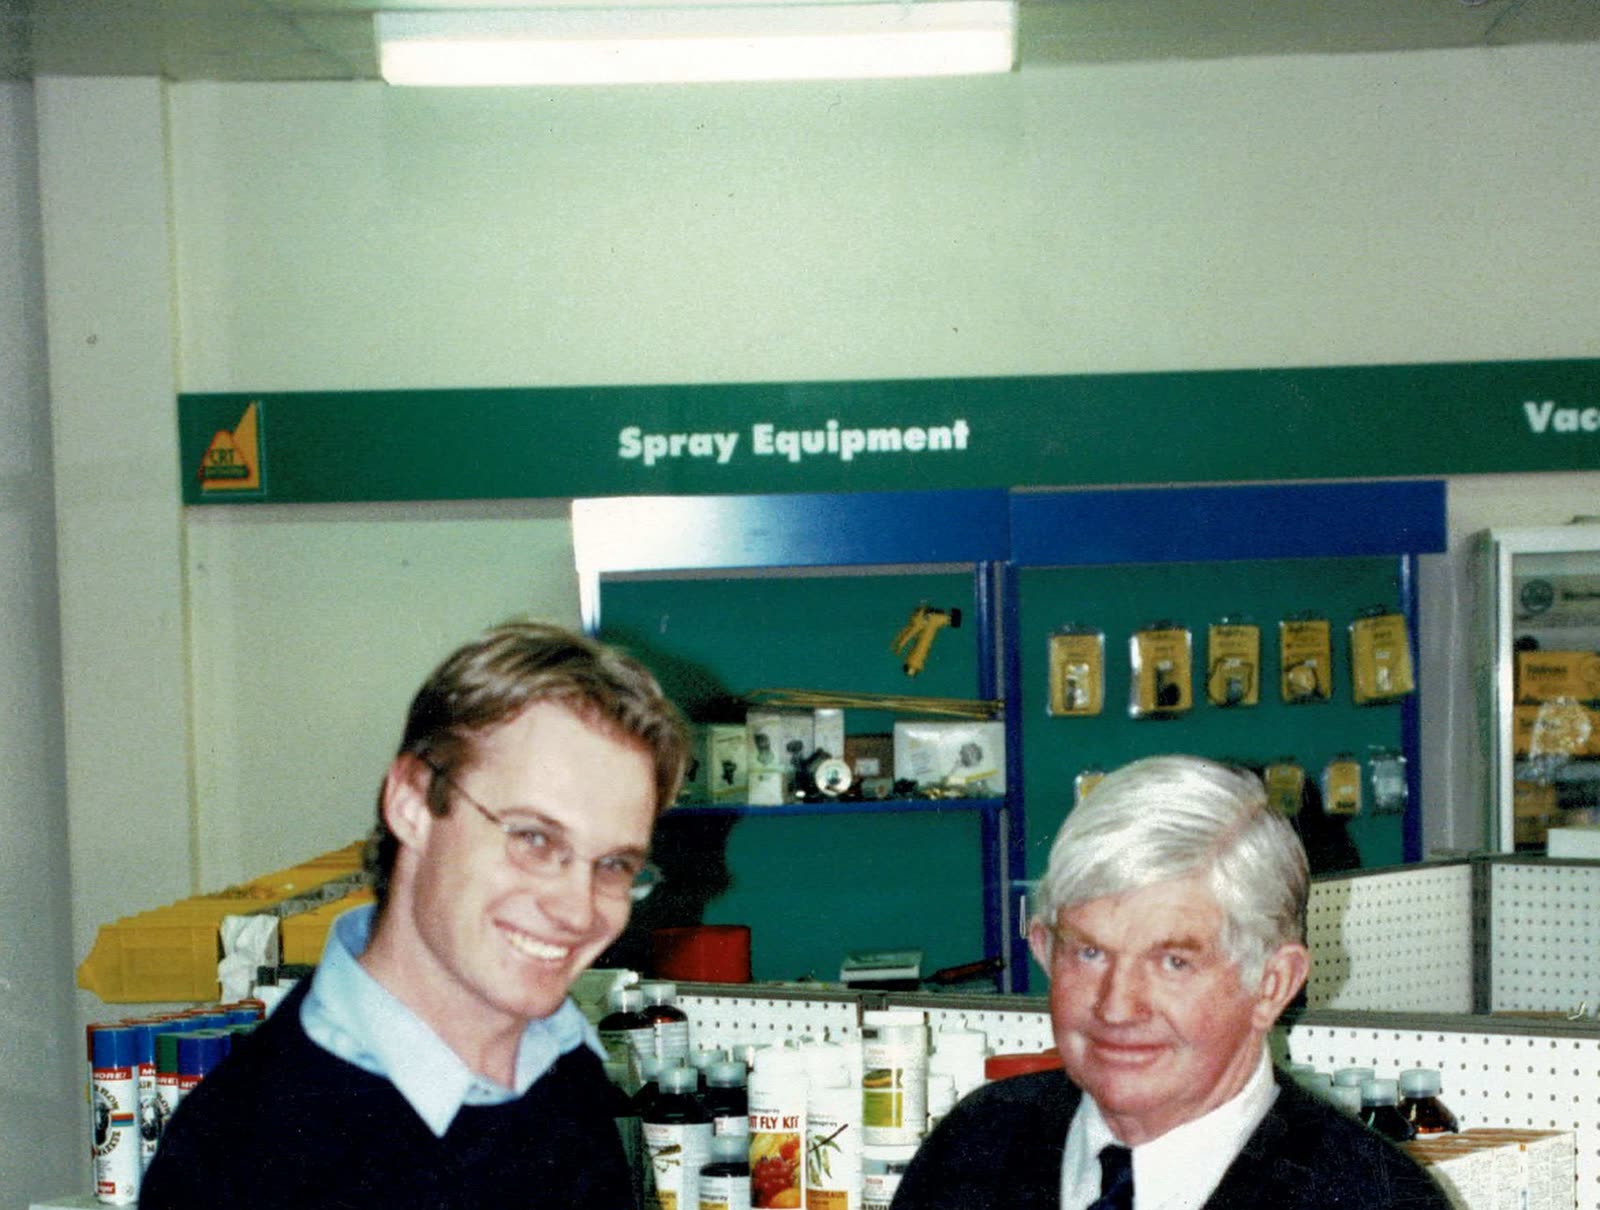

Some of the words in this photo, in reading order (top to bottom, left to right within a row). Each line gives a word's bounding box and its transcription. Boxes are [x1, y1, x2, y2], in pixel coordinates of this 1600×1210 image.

[618, 425, 739, 466] Spray
[752, 419, 970, 461] Equipment
[760, 1116, 778, 1130] FLY
[783, 1114, 800, 1129] KIT
